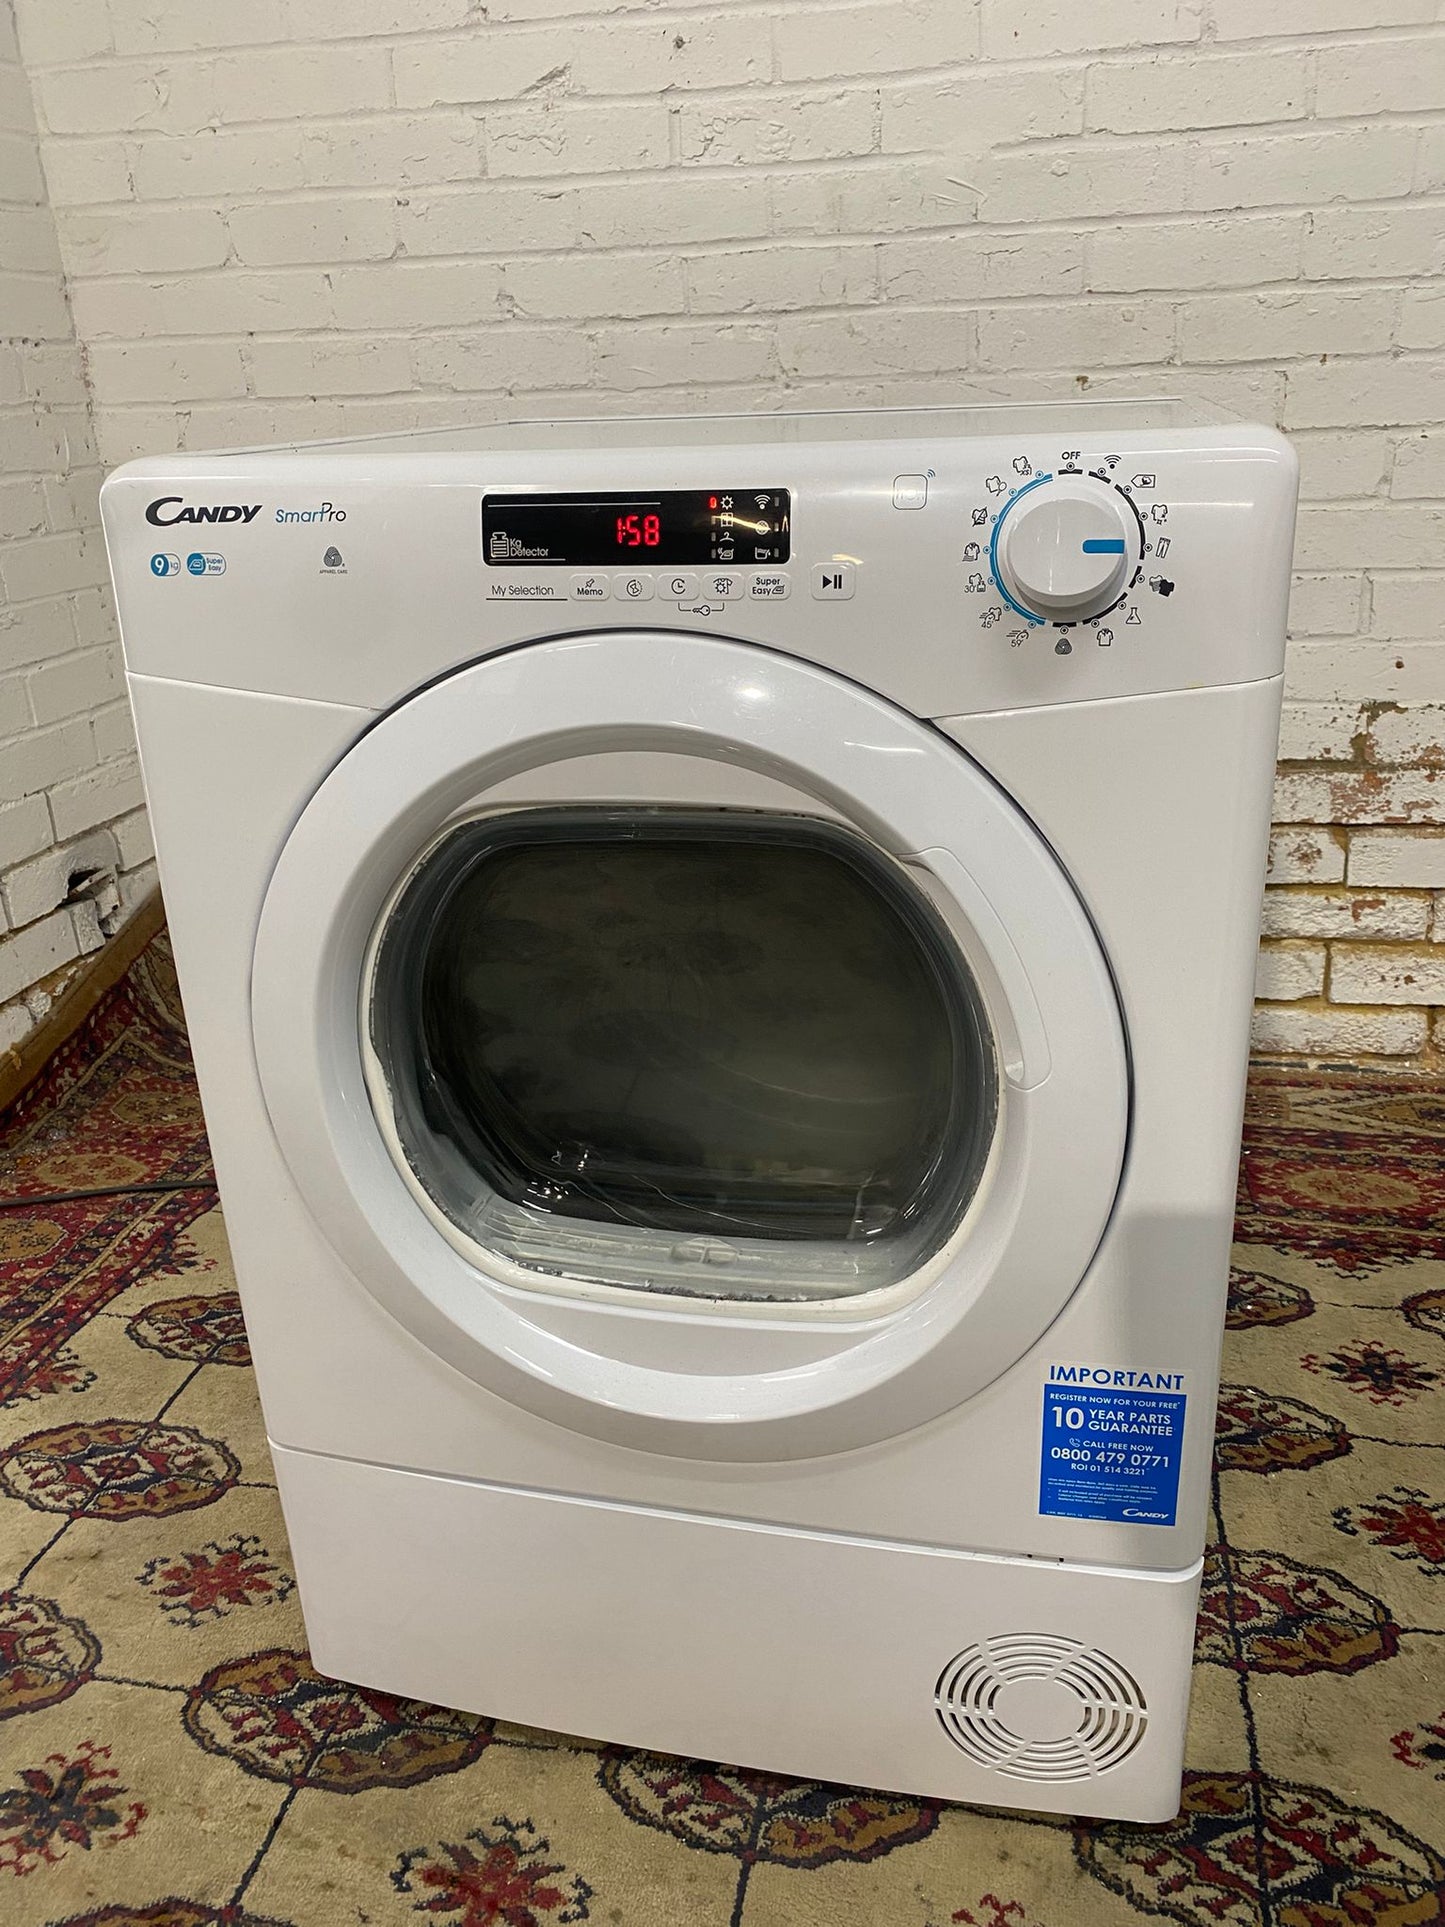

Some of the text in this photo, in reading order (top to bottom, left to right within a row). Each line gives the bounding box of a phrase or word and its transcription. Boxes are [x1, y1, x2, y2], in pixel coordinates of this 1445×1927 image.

[1061, 451, 1081, 460] OFF
[145, 496, 262, 526] CANDY
[509, 538, 522, 549] Kg
[510, 547, 549, 556] Detector
[155, 557, 164, 574] 9
[755, 577, 780, 587] Super
[491, 584, 555, 597] My Selection
[576, 587, 604, 596] Memo
[752, 587, 772, 597] Easy
[1049, 1365, 1185, 1390] IMPORTANT
[1049, 1393, 1087, 1402] REGISTER
[1089, 1396, 1112, 1405] NOW
[1113, 1398, 1131, 1406] FOR
[1133, 1399, 1157, 1409] YOUR
[1051, 1406, 1085, 1430] 10
[1089, 1409, 1171, 1424] YEAR PARTS
[1088, 1421, 1173, 1436] GUARANTEE
[1082, 1440, 1154, 1453] CALL FREE NOW
[1050, 1447, 1170, 1468] 0800 479 0771
[1070, 1463, 1088, 1471] ROI
[1089, 1464, 1101, 1472] 01
[1103, 1466, 1121, 1474] 514
[1122, 1508, 1170, 1520] CANDY
